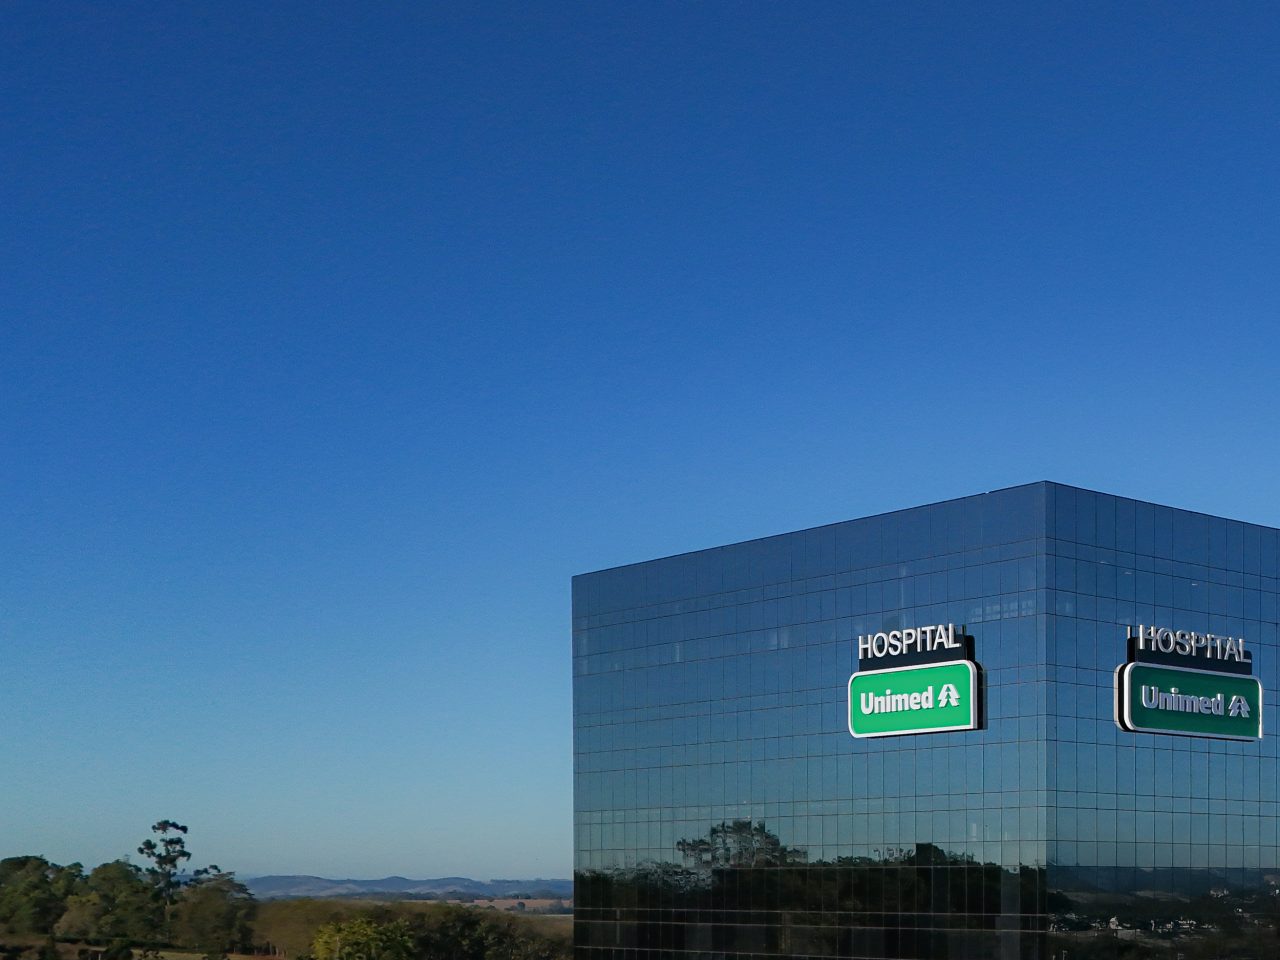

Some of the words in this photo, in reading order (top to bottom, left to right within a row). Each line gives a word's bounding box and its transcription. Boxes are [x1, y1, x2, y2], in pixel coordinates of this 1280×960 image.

[859, 623, 961, 659] HOSPITAL
[1139, 624, 1252, 663] HOSPITAL
[860, 685, 934, 714] Unimed
[1141, 685, 1225, 716] Unimed
